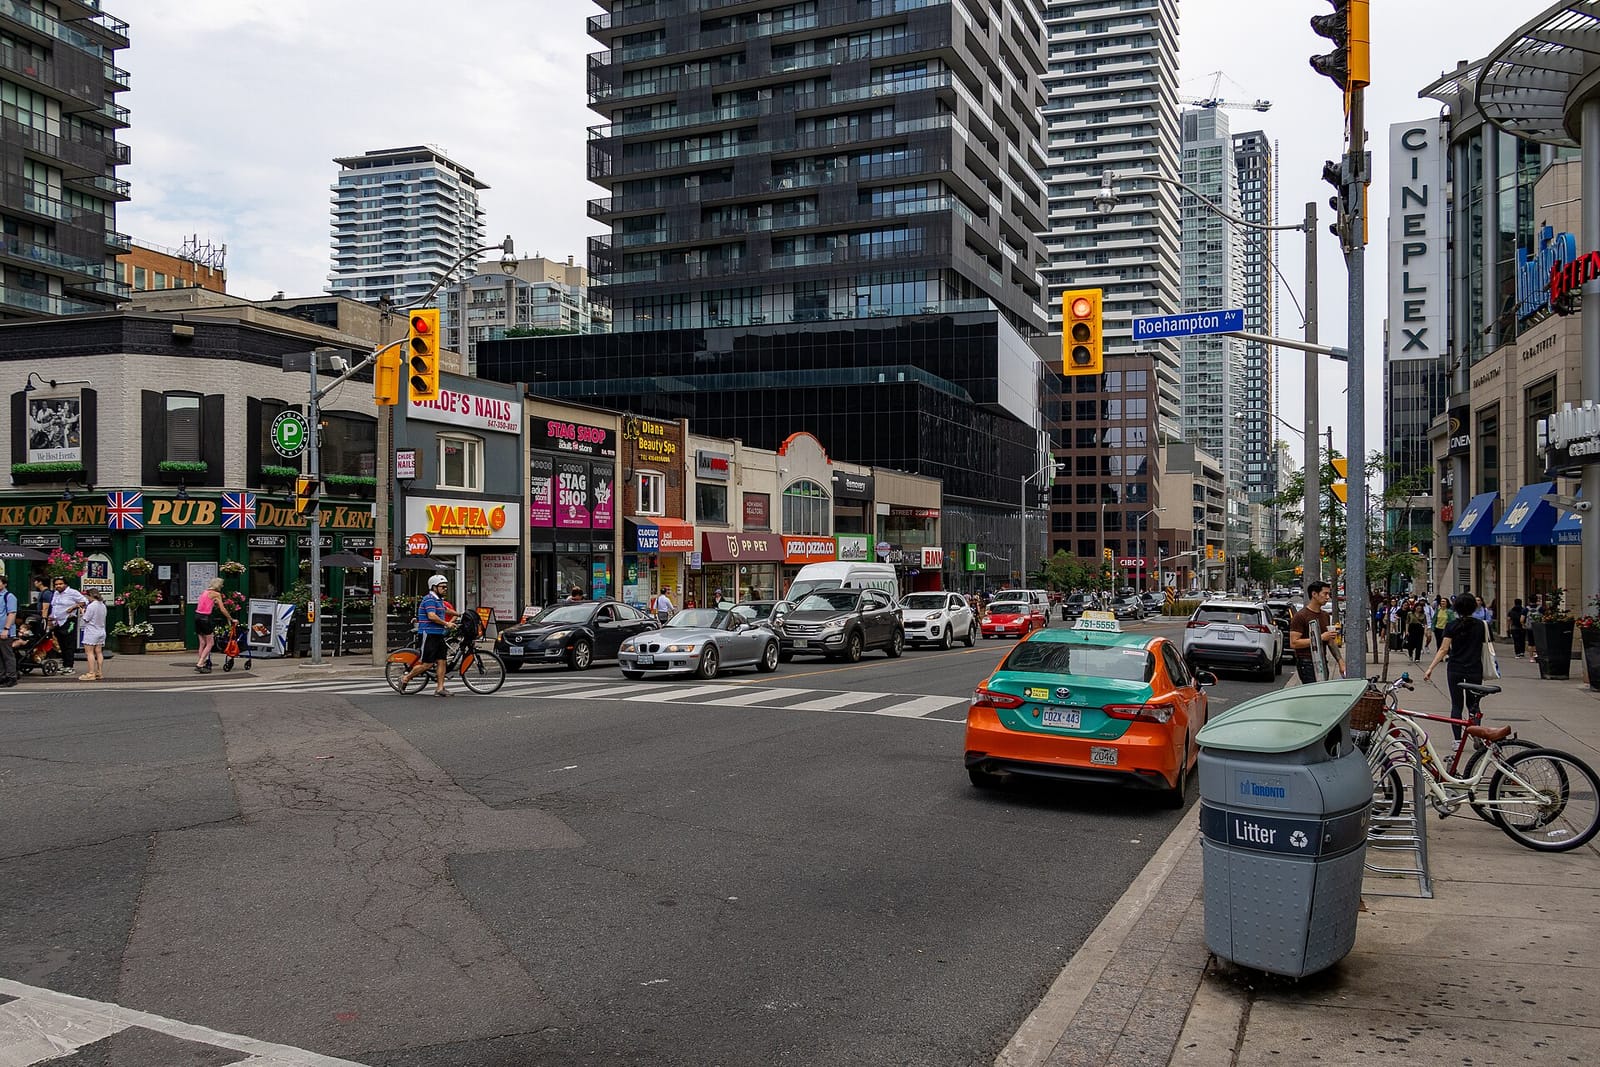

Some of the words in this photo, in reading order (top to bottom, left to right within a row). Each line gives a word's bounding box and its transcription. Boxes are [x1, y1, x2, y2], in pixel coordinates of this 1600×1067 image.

[1402, 128, 1428, 351] CINEPLEX
[1138, 315, 1219, 334] Roehampton
[1224, 311, 1236, 320] Av
[413, 390, 470, 415] LOE'S
[475, 397, 511, 421] NAILS
[283, 423, 298, 441] P
[547, 421, 576, 439] STAG
[577, 426, 606, 444] SHOP
[642, 421, 664, 435] Diana
[273, 436, 308, 456] PARKING
[578, 444, 592, 452] store
[638, 437, 663, 454] Beauty
[663, 440, 676, 454] Spa
[46, 452, 58, 460] Host
[58, 451, 76, 459] Events
[397, 460, 416, 468] NAILS
[559, 473, 586, 490] STAG
[559, 491, 586, 506] SHOP
[29, 506, 53, 525] OF
[54, 501, 107, 526] KENT
[148, 500, 216, 526] PUB
[331, 506, 374, 529] KENT
[427, 504, 489, 533] YAFFA
[638, 529, 658, 537] CLOUDY
[169, 539, 194, 548] 2315
[638, 537, 659, 548] VAPE
[660, 539, 693, 548] CONVENIENCE
[742, 540, 752, 551] PP
[754, 540, 769, 552] PET
[786, 541, 805, 558] pizza
[806, 541, 834, 558] pizza.ca
[1080, 619, 1116, 630] 751-5555
[1094, 751, 1115, 761] 2046
[1251, 783, 1285, 799] TORONTO
[1235, 819, 1277, 845] Litter
